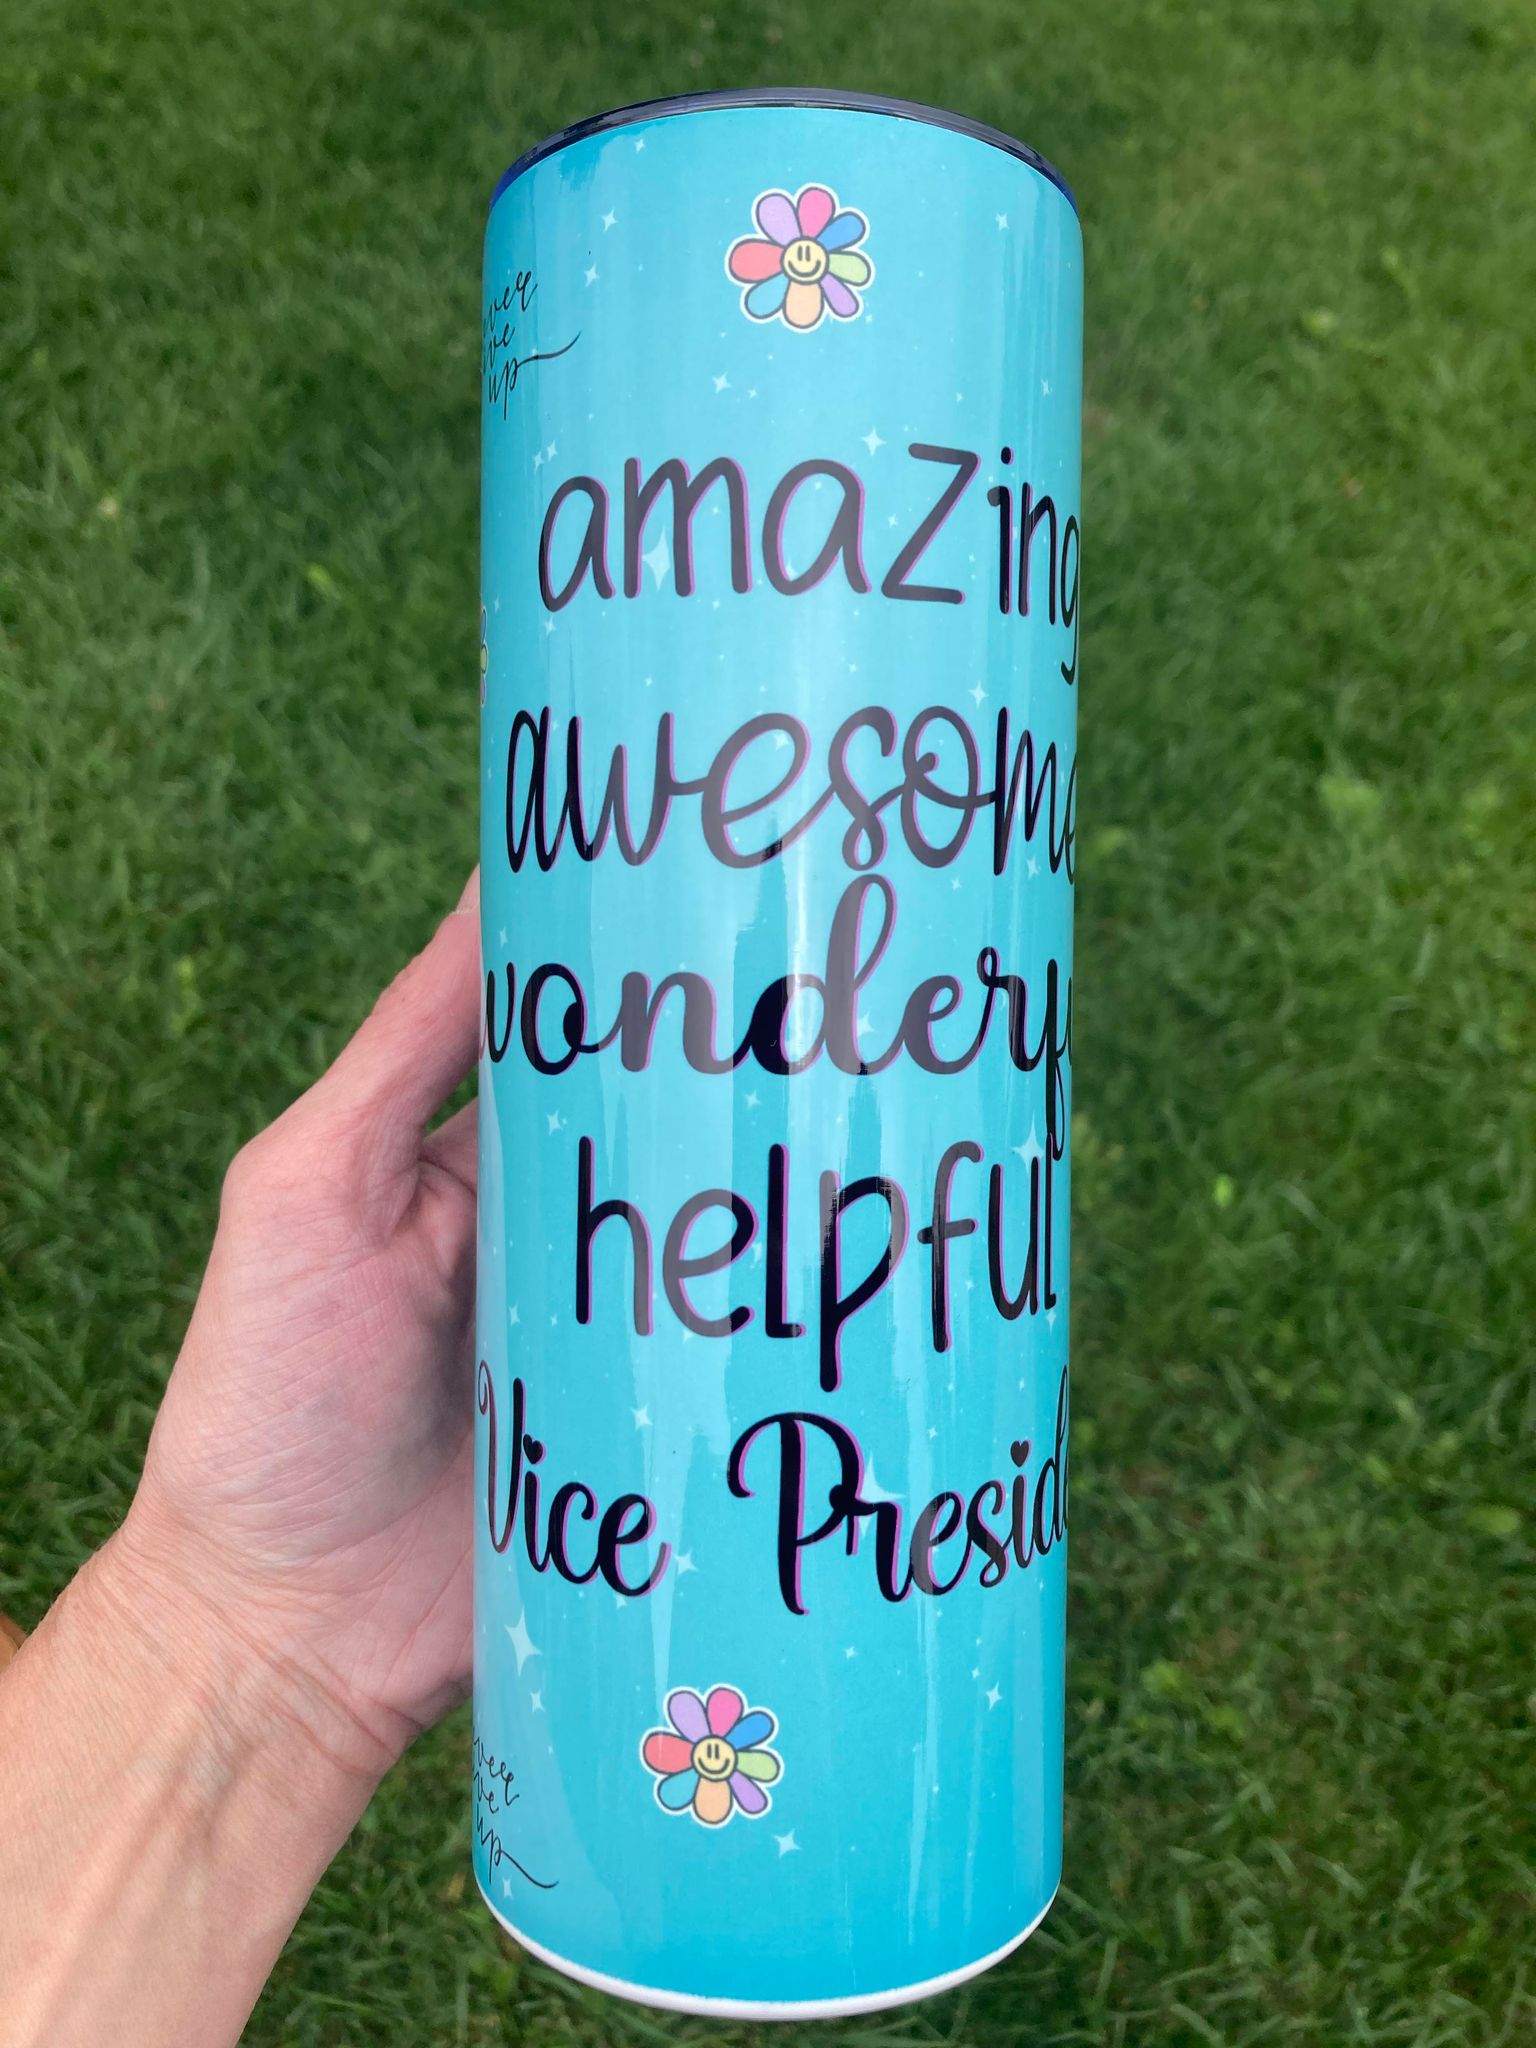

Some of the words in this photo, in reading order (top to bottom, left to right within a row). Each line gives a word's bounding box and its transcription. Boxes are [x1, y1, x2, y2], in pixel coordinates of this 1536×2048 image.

[484, 271, 538, 336] ver
[489, 331, 581, 420] up
[538, 442, 1080, 686] amazing
[480, 873, 1072, 1161] wonderf
[575, 1132, 1058, 1392] helpful
[478, 1360, 672, 1597] Vice
[726, 1364, 1069, 1615] Presid
[473, 1728, 520, 1806] ver
